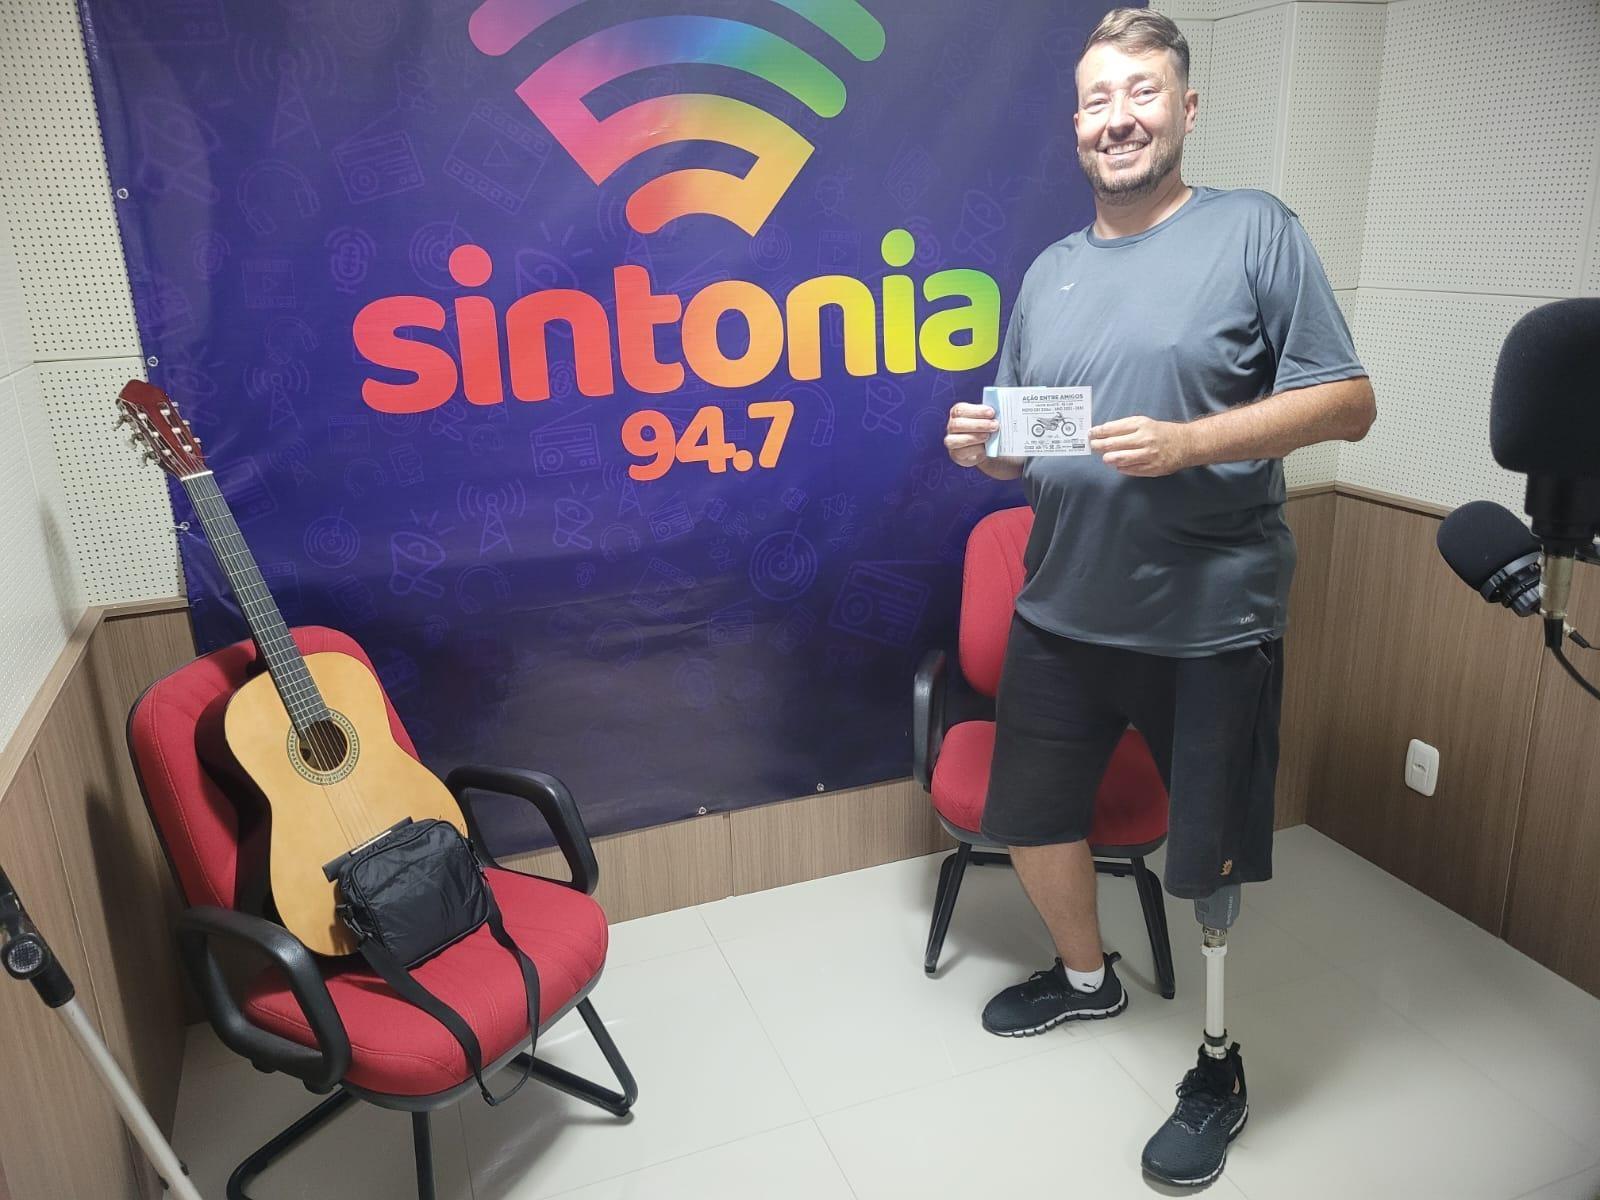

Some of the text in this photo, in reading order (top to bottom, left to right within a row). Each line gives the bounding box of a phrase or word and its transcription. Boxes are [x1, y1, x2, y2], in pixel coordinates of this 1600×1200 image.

[352, 228, 1001, 414] sintonia
[1022, 394, 1039, 402] AÇÃO
[620, 400, 795, 481] 94.7
